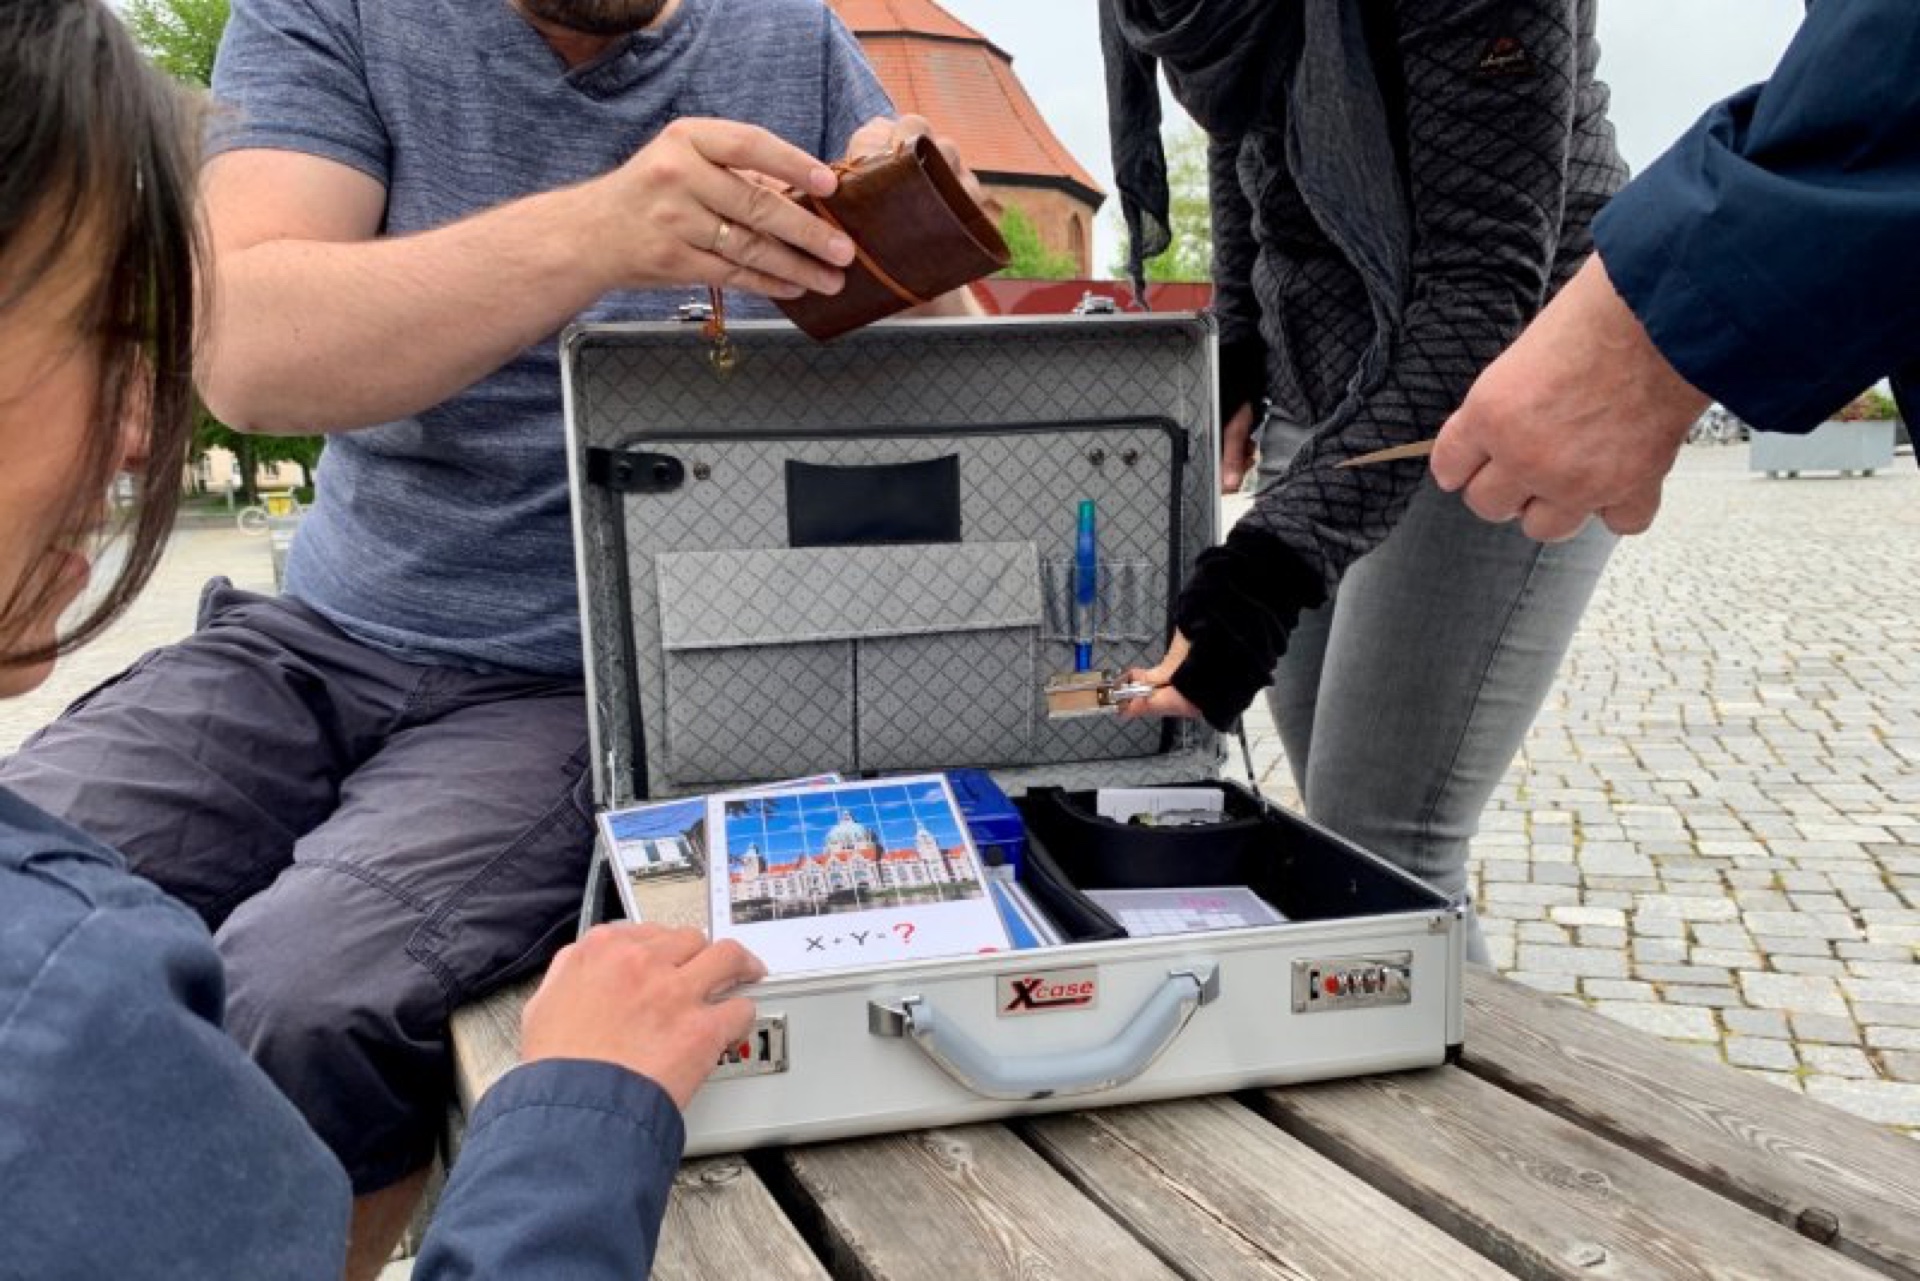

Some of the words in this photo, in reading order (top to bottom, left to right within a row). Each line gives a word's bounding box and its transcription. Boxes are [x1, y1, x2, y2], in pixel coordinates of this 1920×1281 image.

[806, 936, 825, 952] X
[850, 930, 870, 946] Y
[893, 923, 916, 944] ?
[1005, 978, 1094, 1010] Xcase
